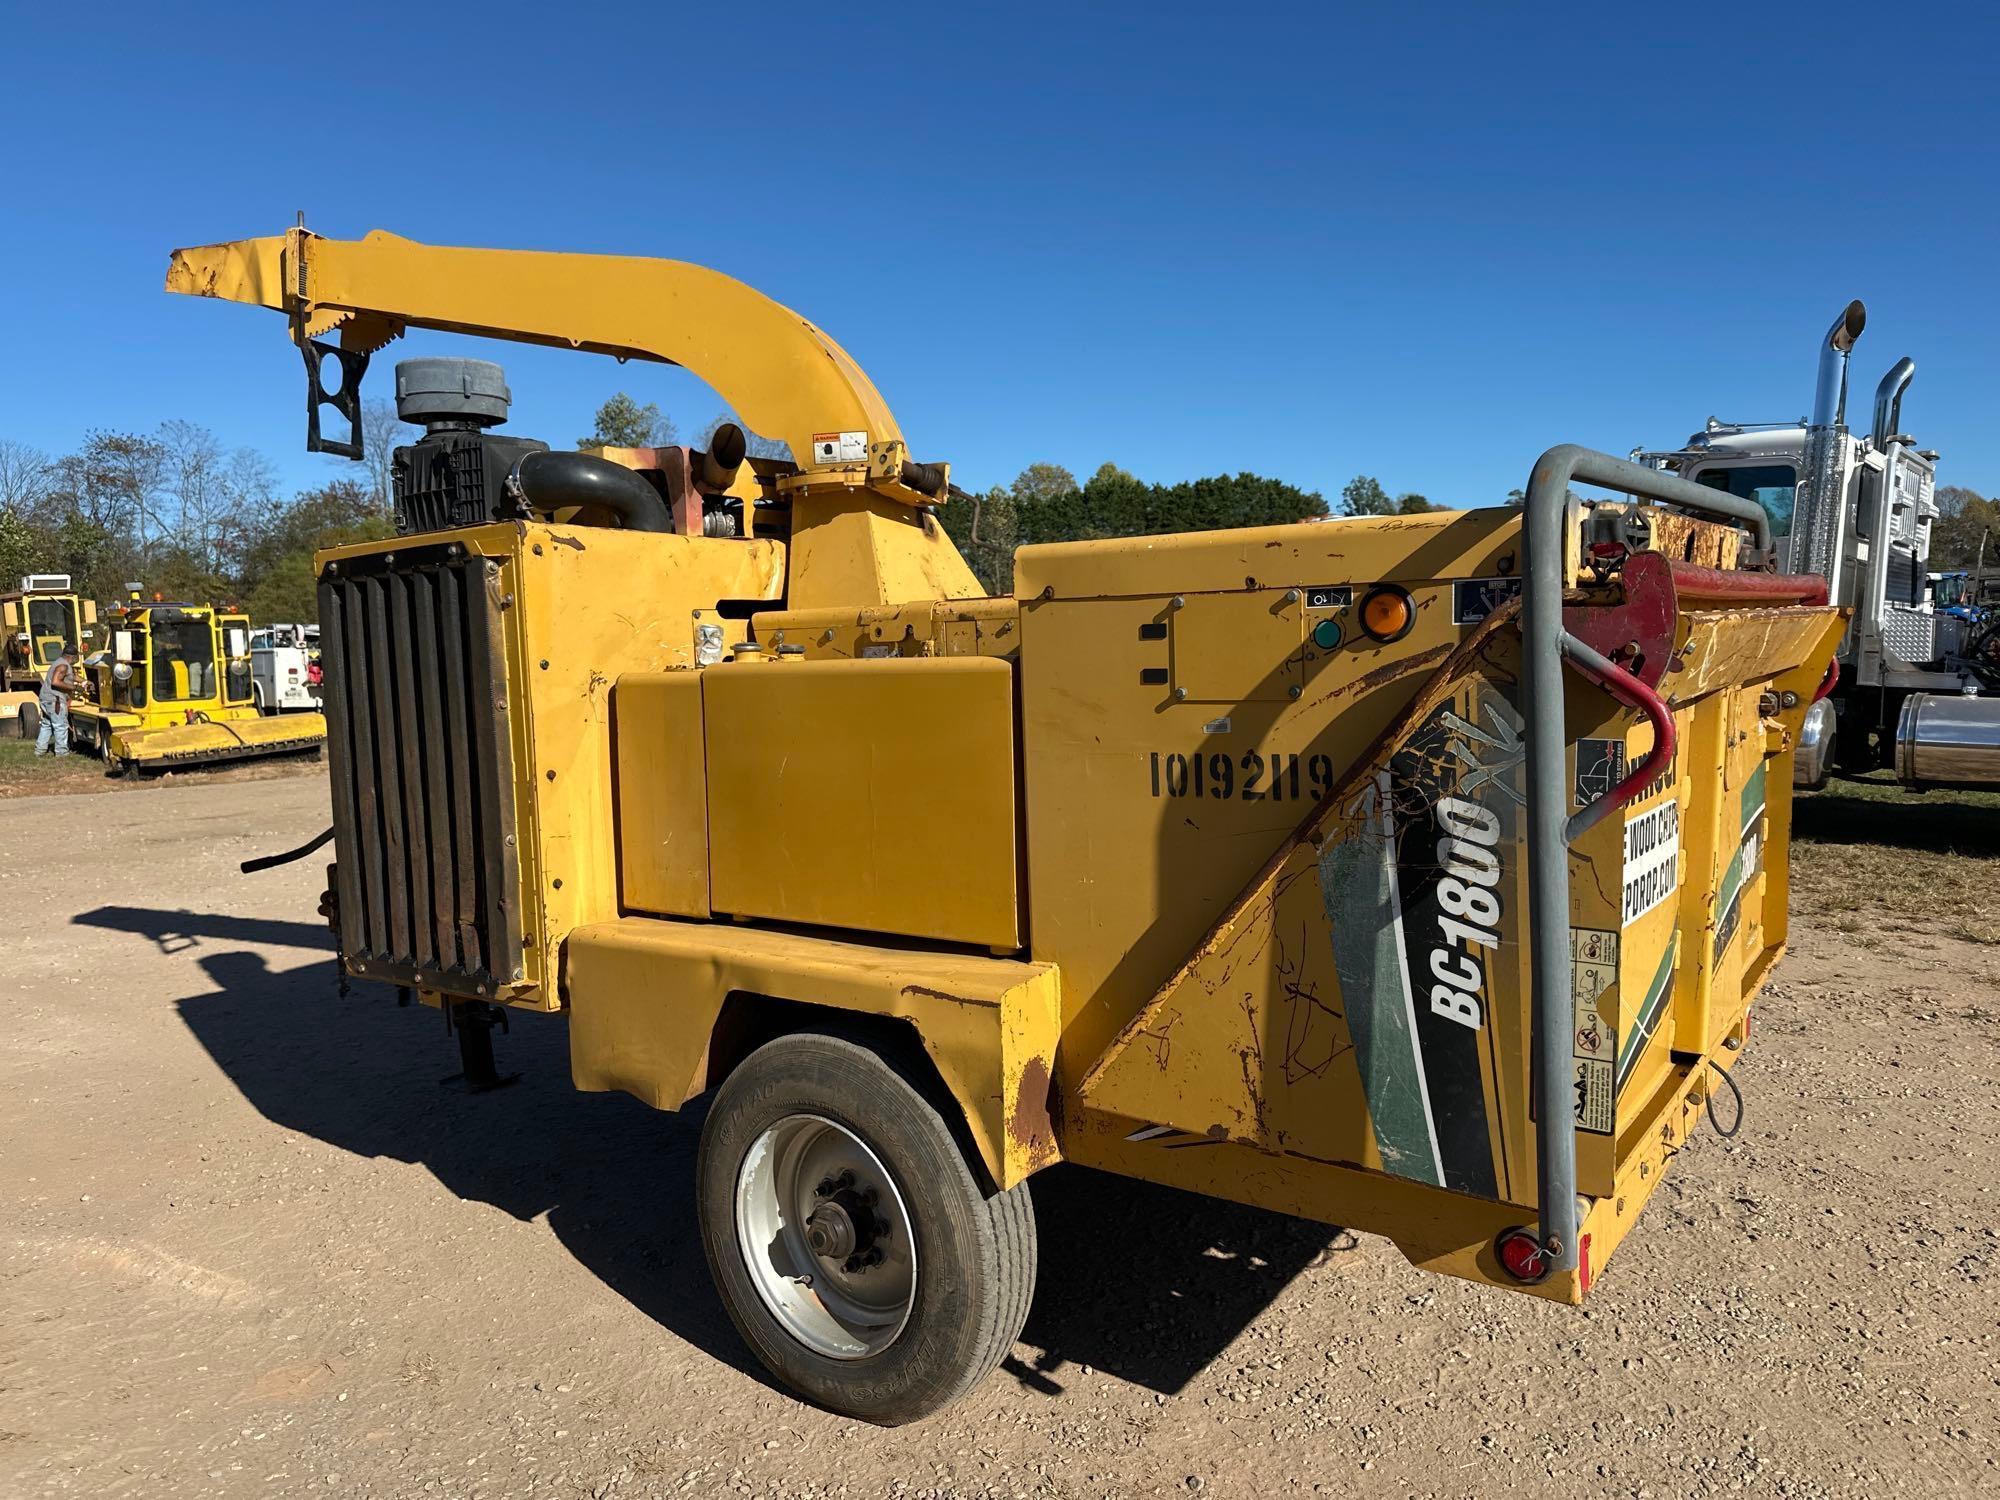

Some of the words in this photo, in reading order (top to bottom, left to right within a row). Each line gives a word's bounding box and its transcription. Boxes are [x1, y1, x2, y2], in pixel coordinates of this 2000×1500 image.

[1149, 752, 1334, 801] 10192119
[1630, 813, 1656, 862] WOOD
[1430, 797, 1504, 1031] BC1800
[1622, 853, 1677, 922] PDROP.COM
